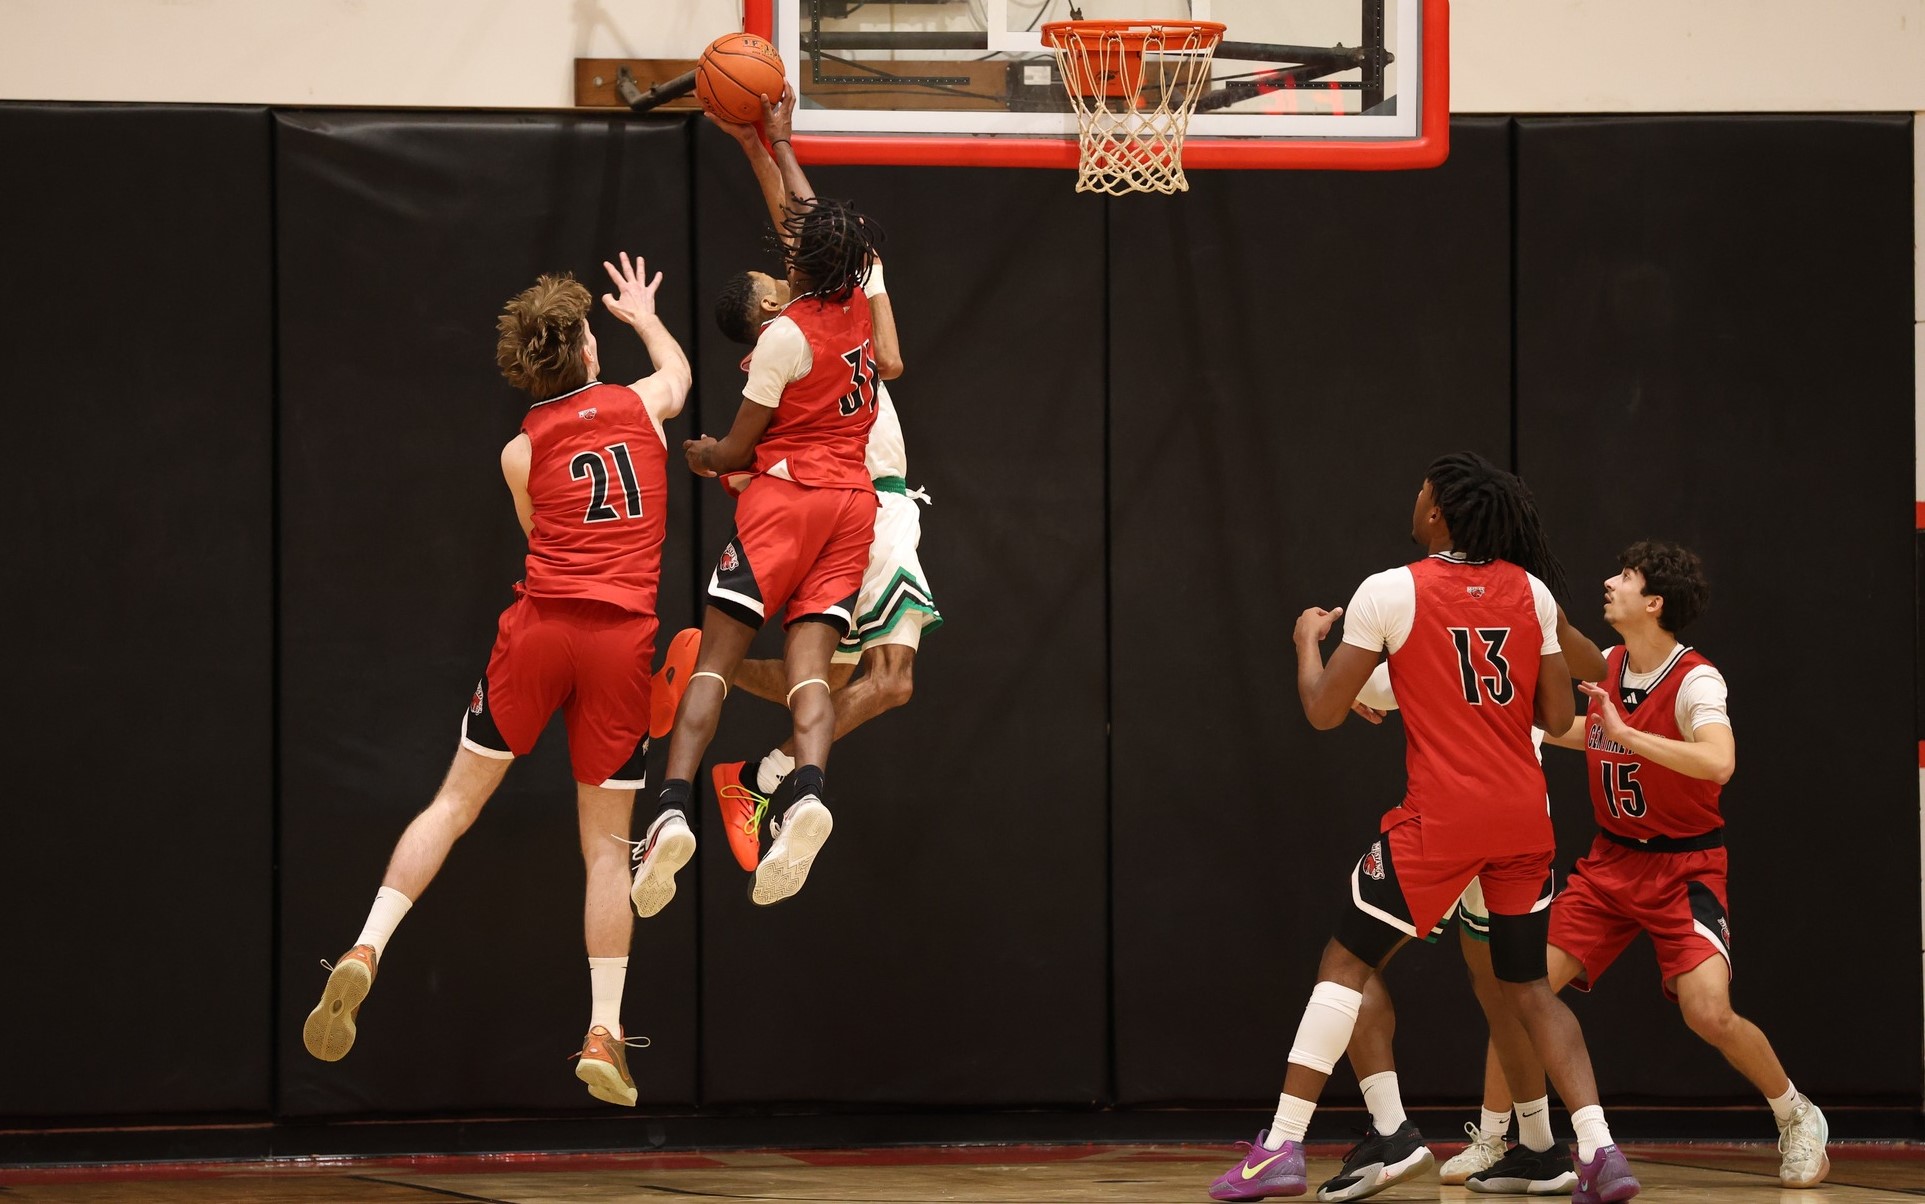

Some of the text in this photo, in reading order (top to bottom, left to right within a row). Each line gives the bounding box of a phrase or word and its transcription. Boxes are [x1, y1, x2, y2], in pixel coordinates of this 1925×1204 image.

[839, 338, 879, 417] 31
[569, 442, 643, 524] 21
[1446, 627, 1515, 706] 13
[1601, 760, 1648, 818] 15
